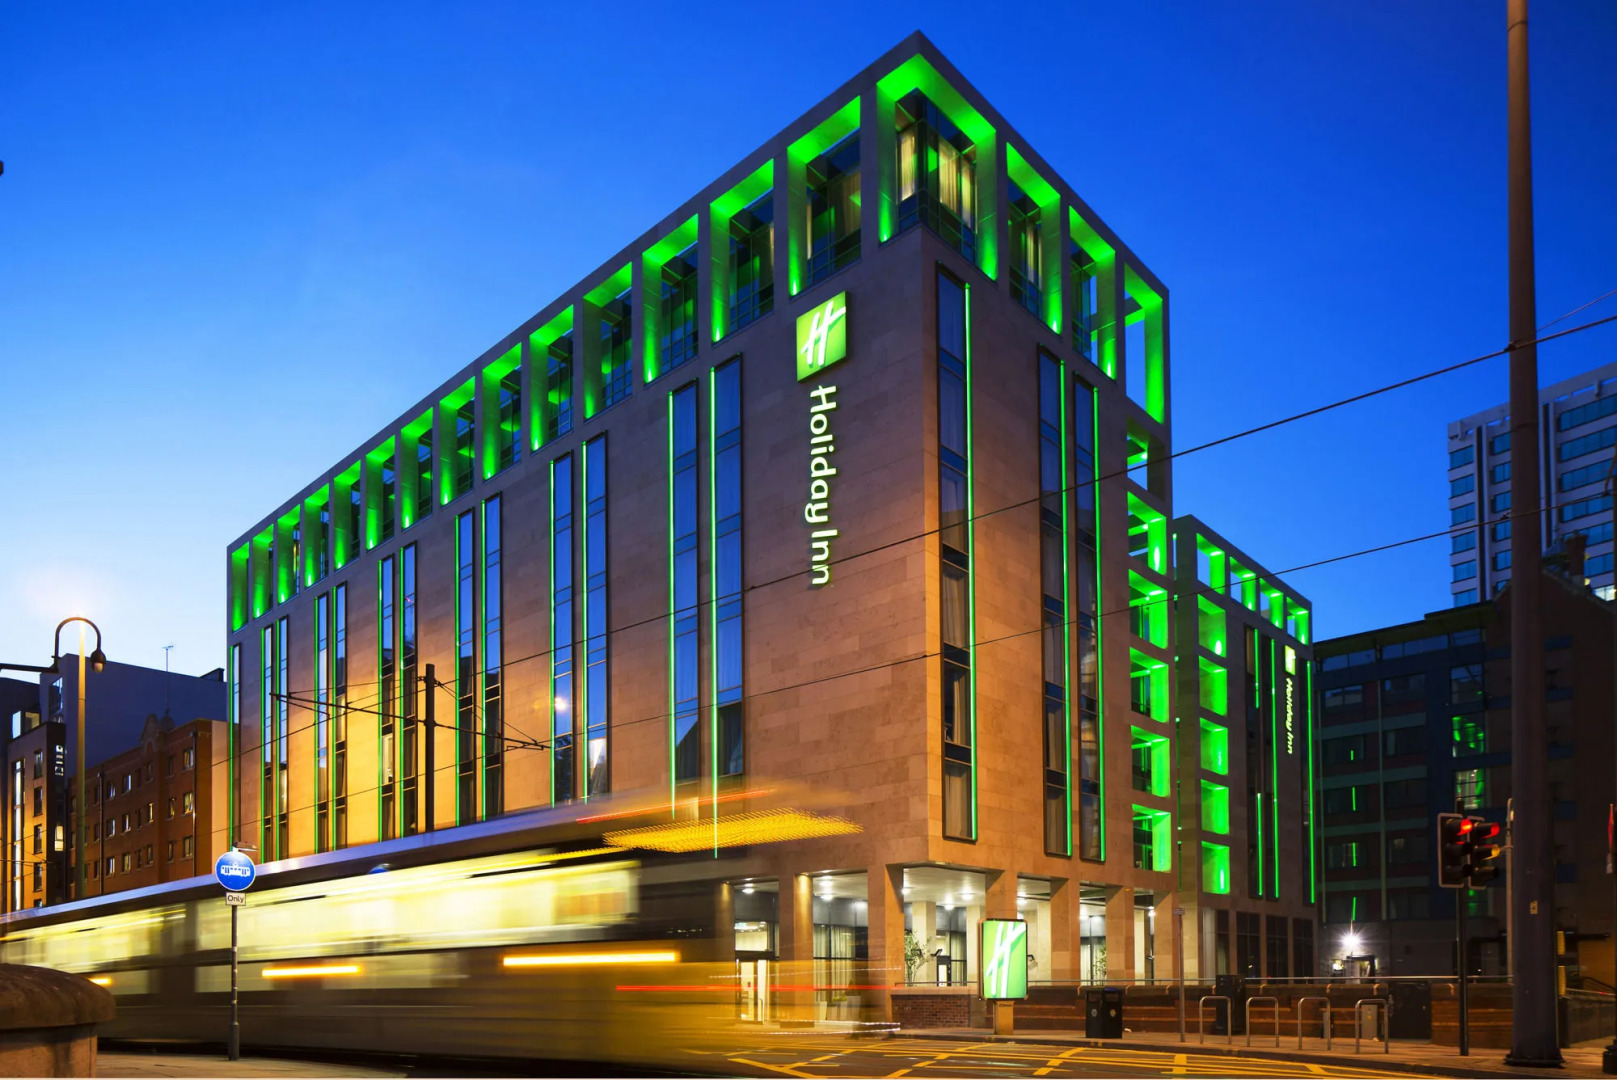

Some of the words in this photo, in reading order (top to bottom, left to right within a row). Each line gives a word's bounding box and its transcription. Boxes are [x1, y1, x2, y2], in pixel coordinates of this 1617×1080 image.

[804, 385, 837, 523] Holiday
[811, 529, 838, 585] Inn
[227, 895, 244, 903] Only
